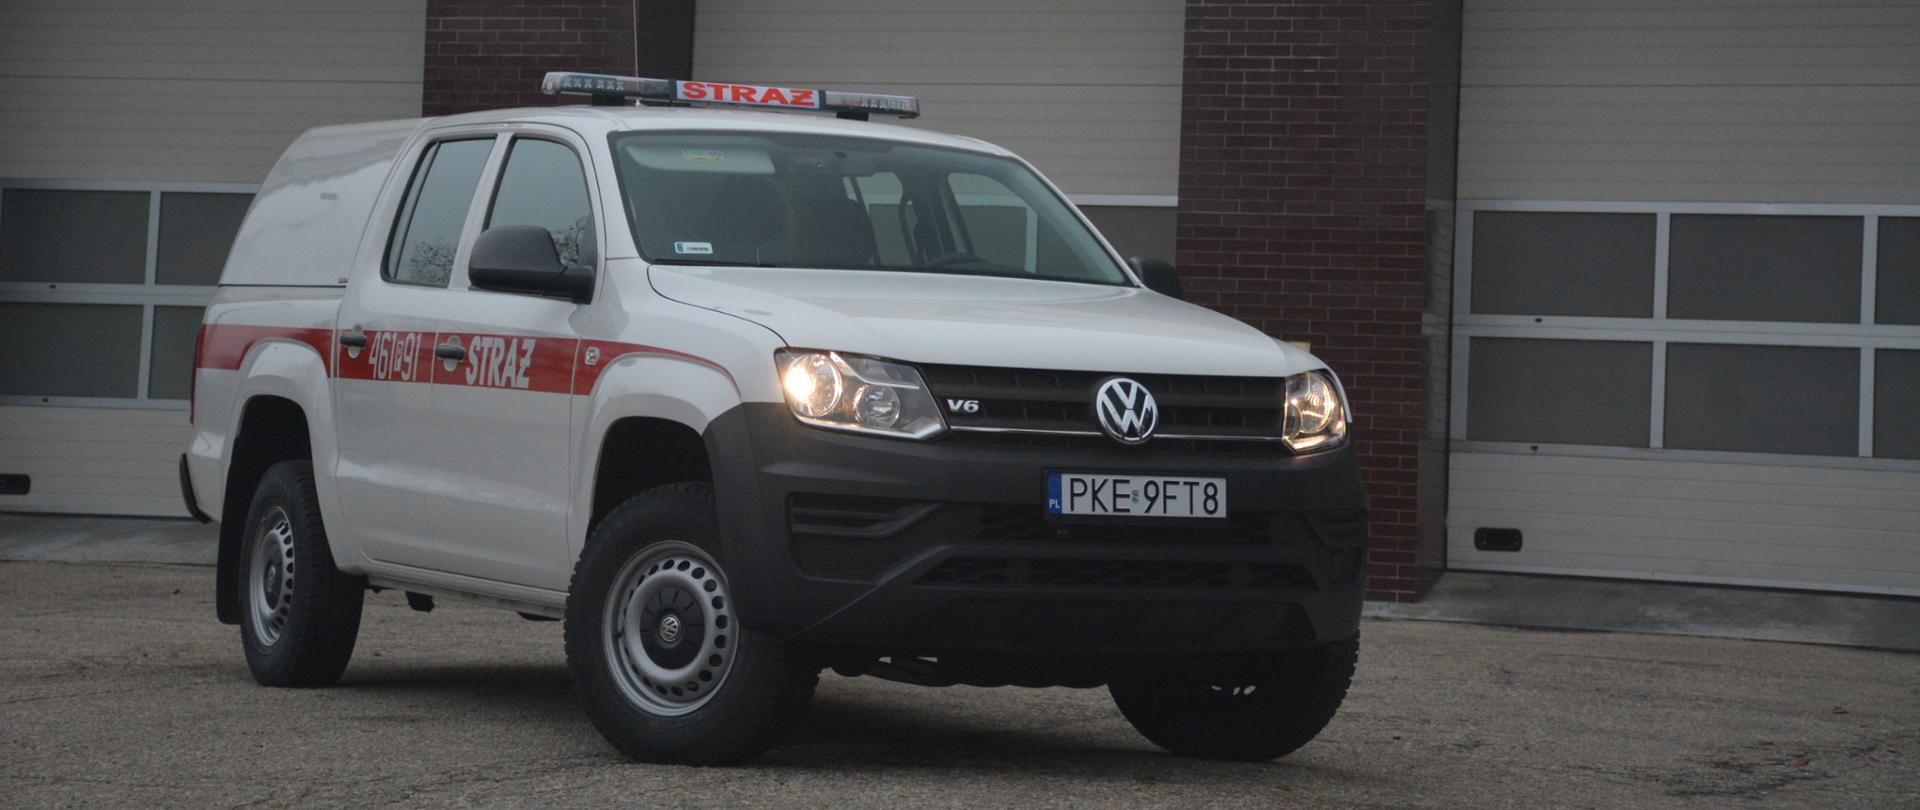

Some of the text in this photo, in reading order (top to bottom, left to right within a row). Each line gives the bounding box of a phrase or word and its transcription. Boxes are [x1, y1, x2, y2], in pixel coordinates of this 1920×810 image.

[947, 399, 979, 413] V6
[1070, 477, 1218, 515] PKE 9FT8
[1049, 499, 1060, 508] PL
